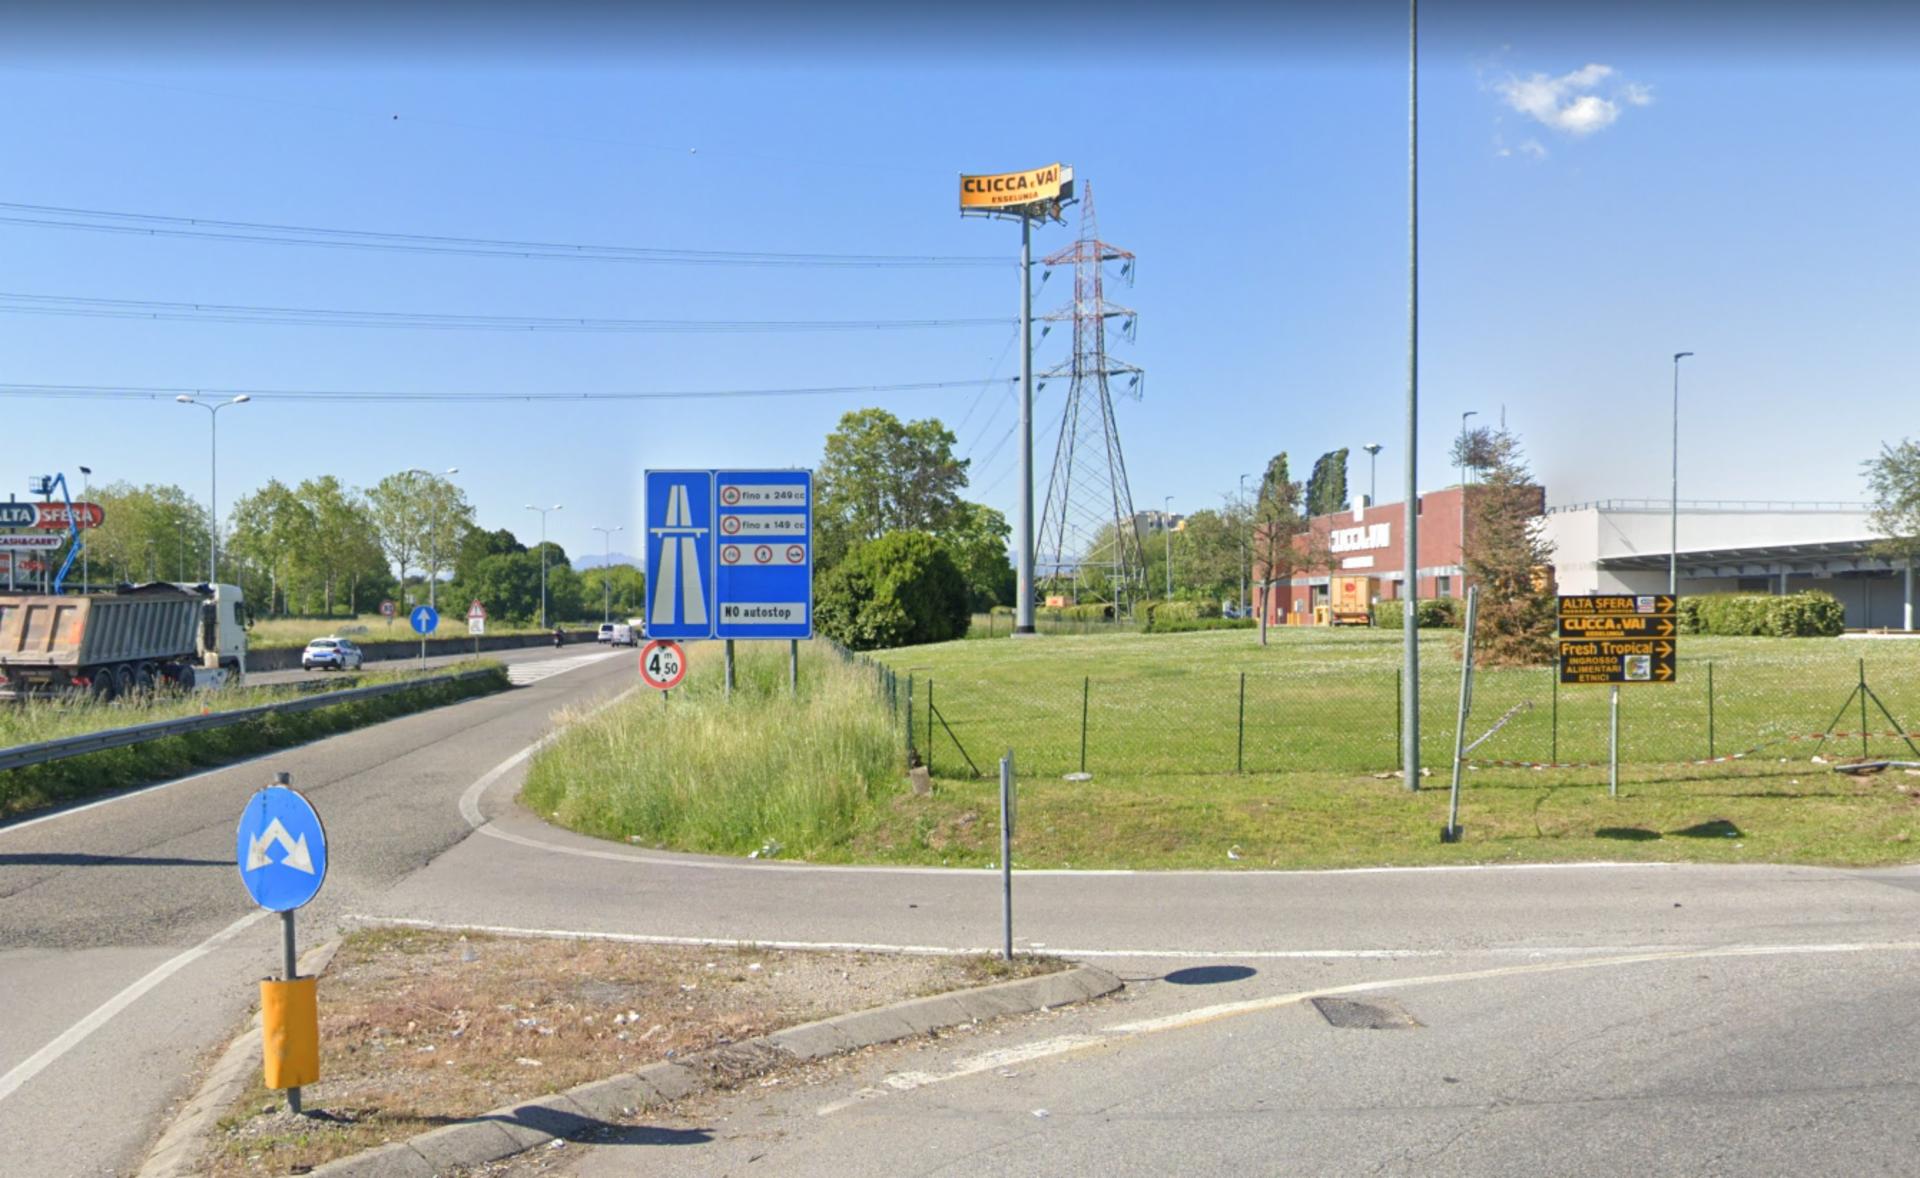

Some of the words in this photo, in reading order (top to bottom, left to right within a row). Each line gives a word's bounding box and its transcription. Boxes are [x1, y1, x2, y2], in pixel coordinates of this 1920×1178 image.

[964, 175, 1027, 193] CLICCA
[1036, 167, 1058, 186] VAI
[742, 490, 760, 500] fino
[774, 491, 792, 500] 249
[0, 508, 31, 522] LTA
[42, 508, 93, 522] SFERA
[742, 520, 760, 530] fino
[774, 520, 791, 530] 149
[1563, 598, 1592, 609] ALTA
[1595, 598, 1634, 609] SFERA
[725, 606, 740, 618] NO
[743, 605, 791, 619] autostop
[1564, 618, 1615, 630] CLICCA
[1621, 618, 1646, 630] VAI
[1562, 643, 1597, 655] Fresh
[1601, 641, 1653, 656] Tropical
[1569, 656, 1618, 665] INGROSSO
[1566, 665, 1622, 674] ALIMENTARI
[1579, 674, 1609, 682] ETNICI
